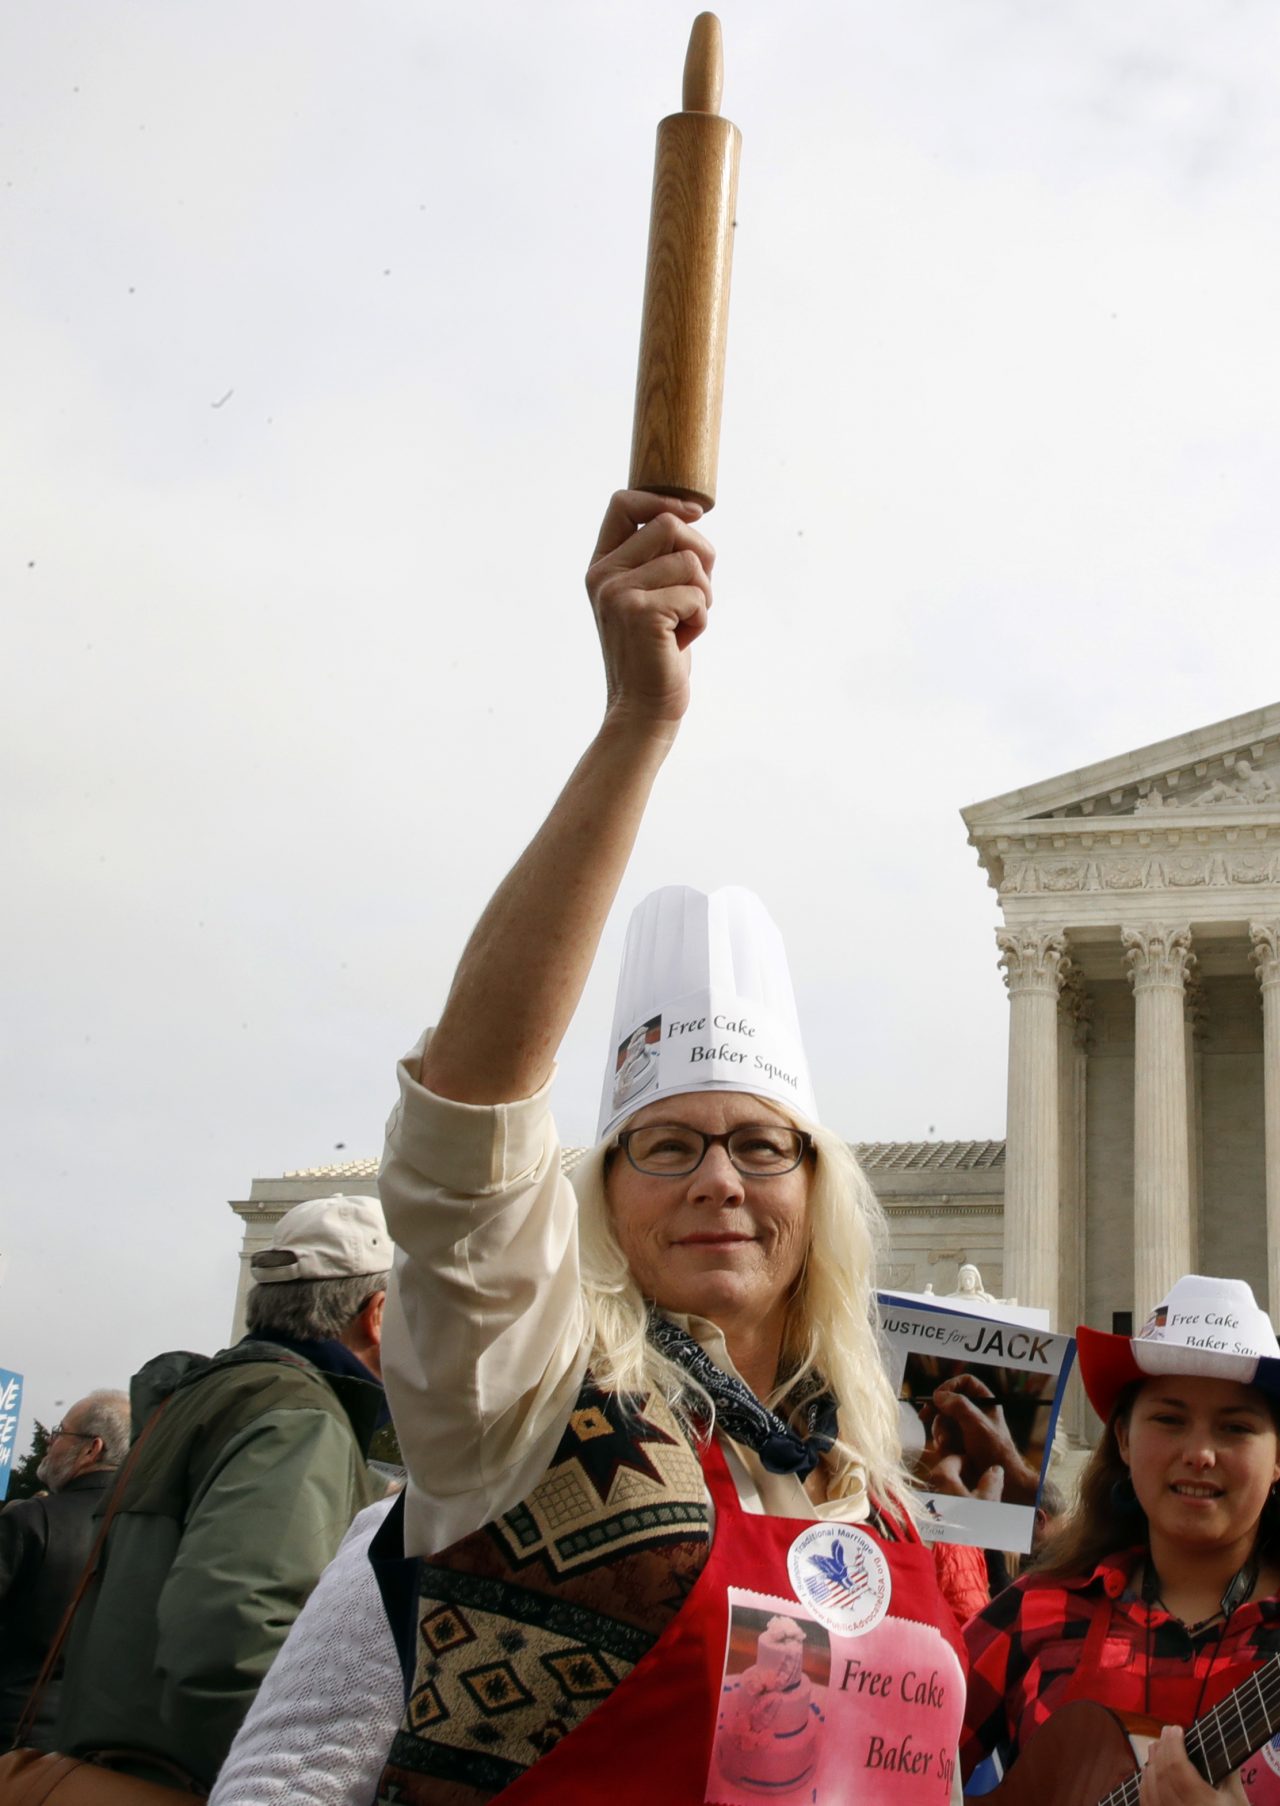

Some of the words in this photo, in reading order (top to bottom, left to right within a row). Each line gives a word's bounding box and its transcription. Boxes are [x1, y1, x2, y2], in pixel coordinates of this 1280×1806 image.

[668, 1017, 706, 1038] Free
[713, 1015, 756, 1038] Cake
[689, 1043, 748, 1064] Baker
[753, 1055, 800, 1090] Squad
[1171, 1313, 1200, 1327] Free
[1204, 1312, 1239, 1329] Cake
[882, 1319, 946, 1340] JUSTICE
[942, 1328, 967, 1345] for
[964, 1327, 1054, 1364] JACK
[1186, 1334, 1228, 1350] Baker
[795, 1528, 835, 1554] Traditional
[837, 1529, 874, 1555] Marriage
[839, 1658, 893, 1698] Free
[900, 1668, 945, 1709] Cake
[864, 1734, 933, 1776] Baker
